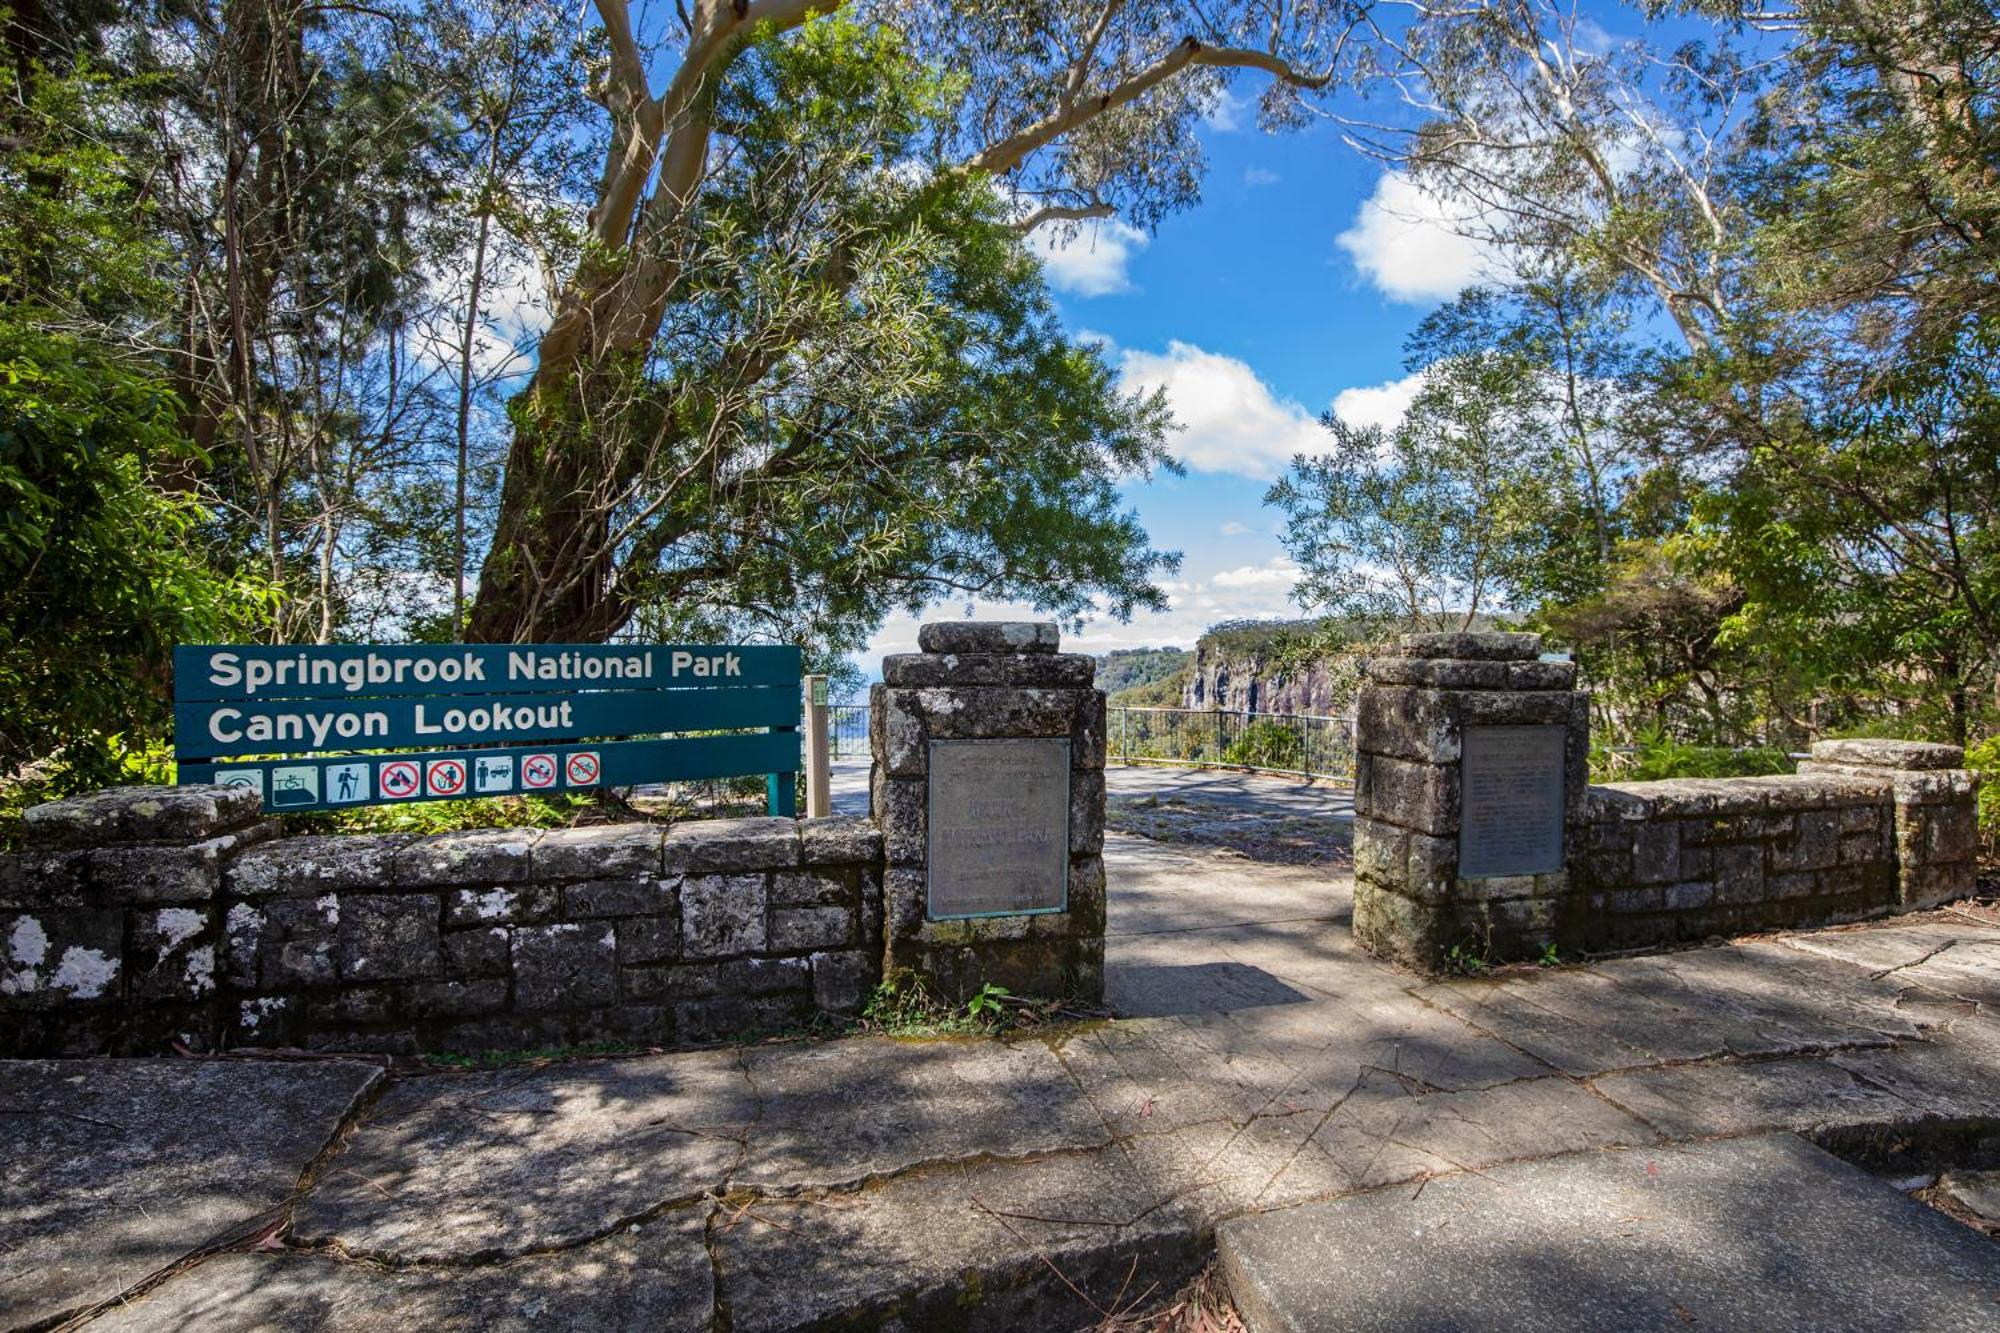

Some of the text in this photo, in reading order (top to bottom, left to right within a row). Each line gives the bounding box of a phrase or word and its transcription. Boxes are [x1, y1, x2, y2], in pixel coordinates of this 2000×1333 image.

[209, 651, 742, 693] Springbrook National Park
[208, 700, 573, 747] Canyon Lookout
